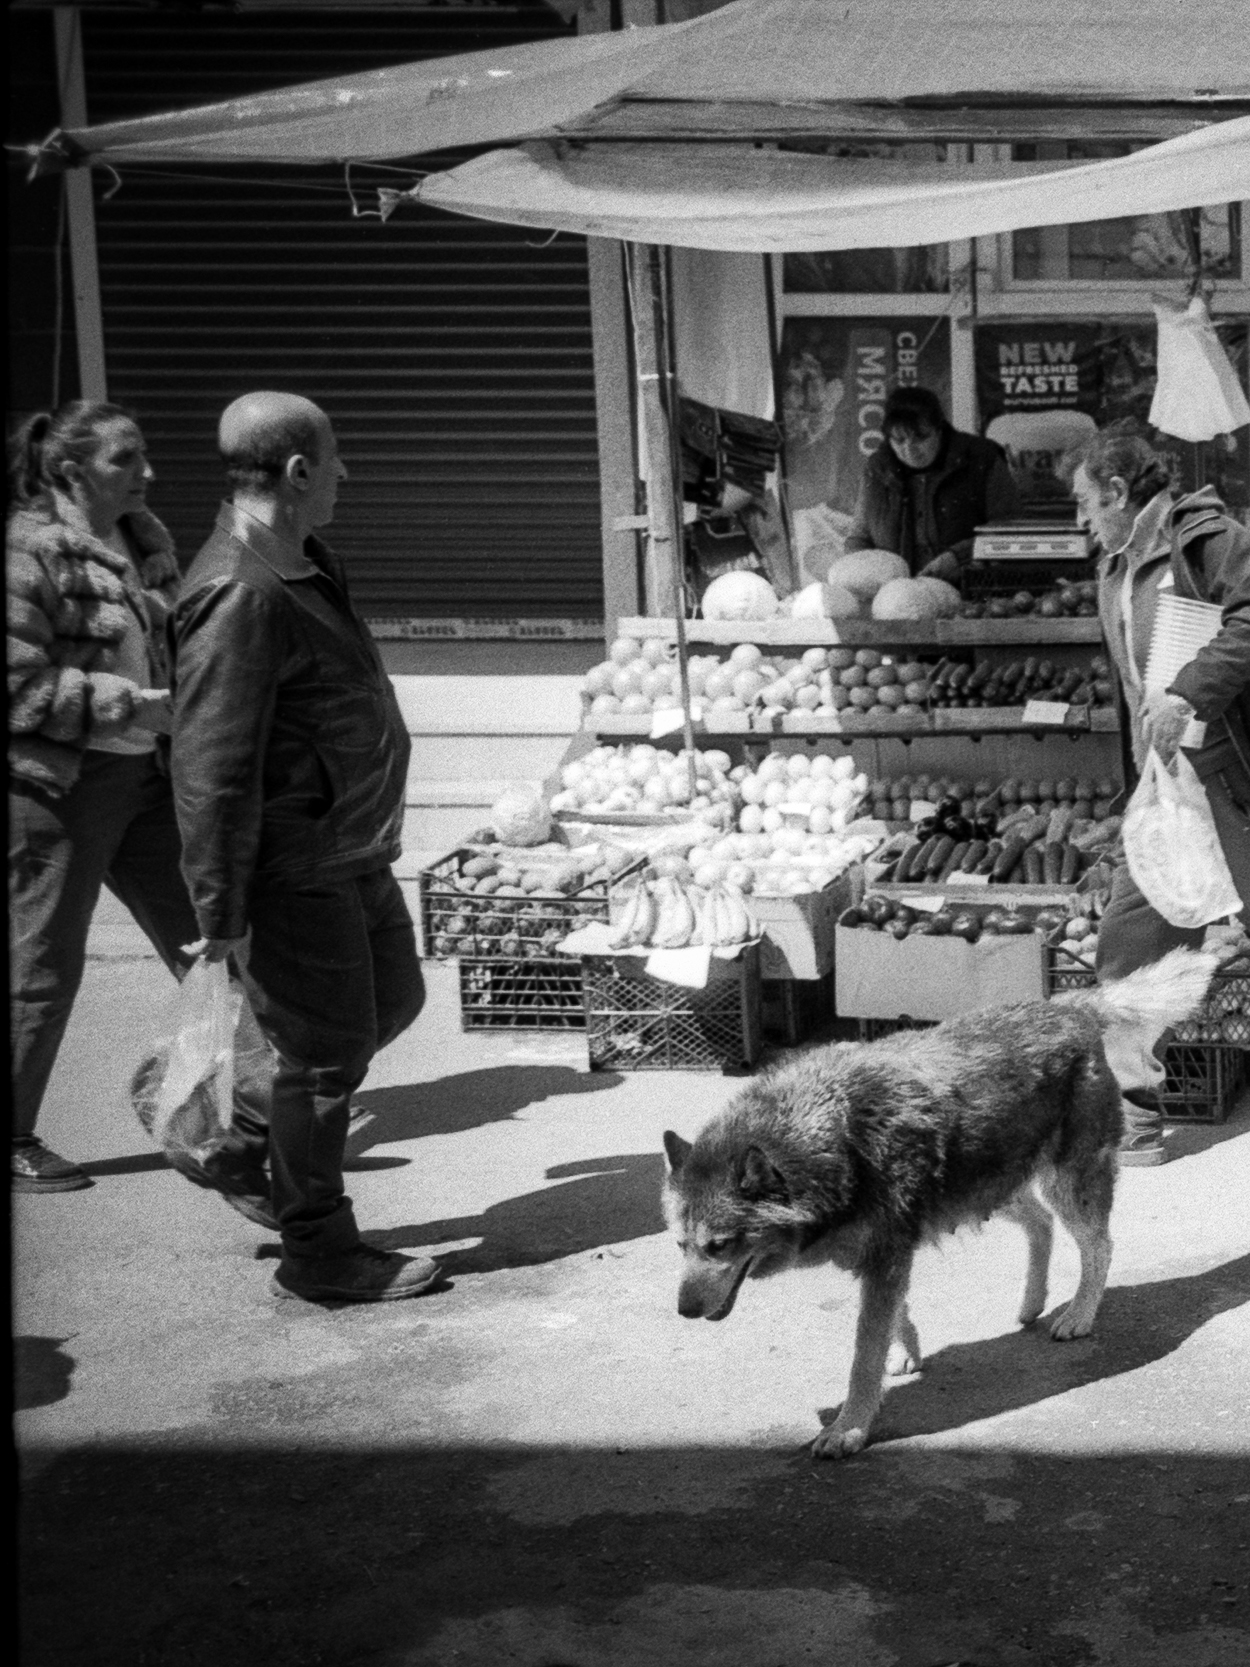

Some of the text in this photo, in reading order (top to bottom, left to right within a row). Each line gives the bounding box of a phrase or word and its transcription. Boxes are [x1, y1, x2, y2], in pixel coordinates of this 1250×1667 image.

[998, 341, 1077, 364] NEW
[999, 364, 1079, 375] REFRESHED
[999, 375, 1079, 394] TASTE
[855, 346, 887, 457] МЯСО
